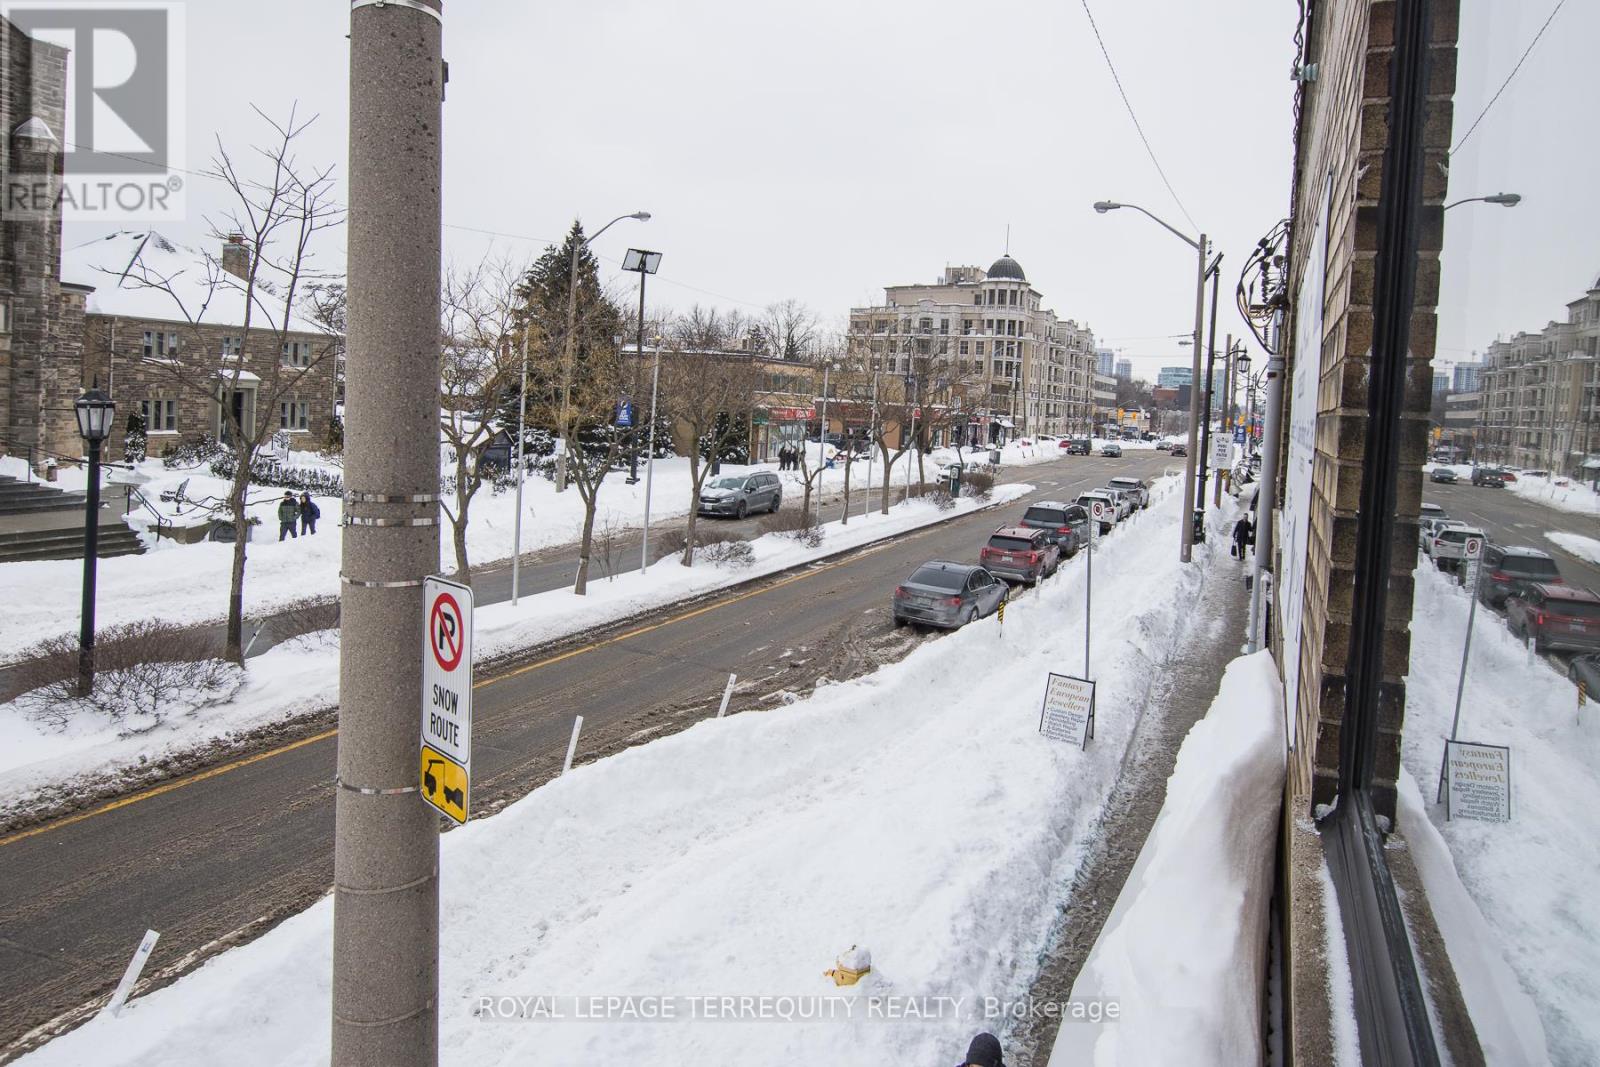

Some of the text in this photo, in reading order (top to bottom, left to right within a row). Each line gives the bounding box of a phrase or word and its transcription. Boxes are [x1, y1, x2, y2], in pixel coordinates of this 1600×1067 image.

[1052, 678, 1083, 691] Fantasy
[433, 683, 458, 715] SNOW
[1050, 688, 1090, 703] European
[1048, 697, 1085, 711] Jewellers
[430, 711, 459, 747] ROUTE
